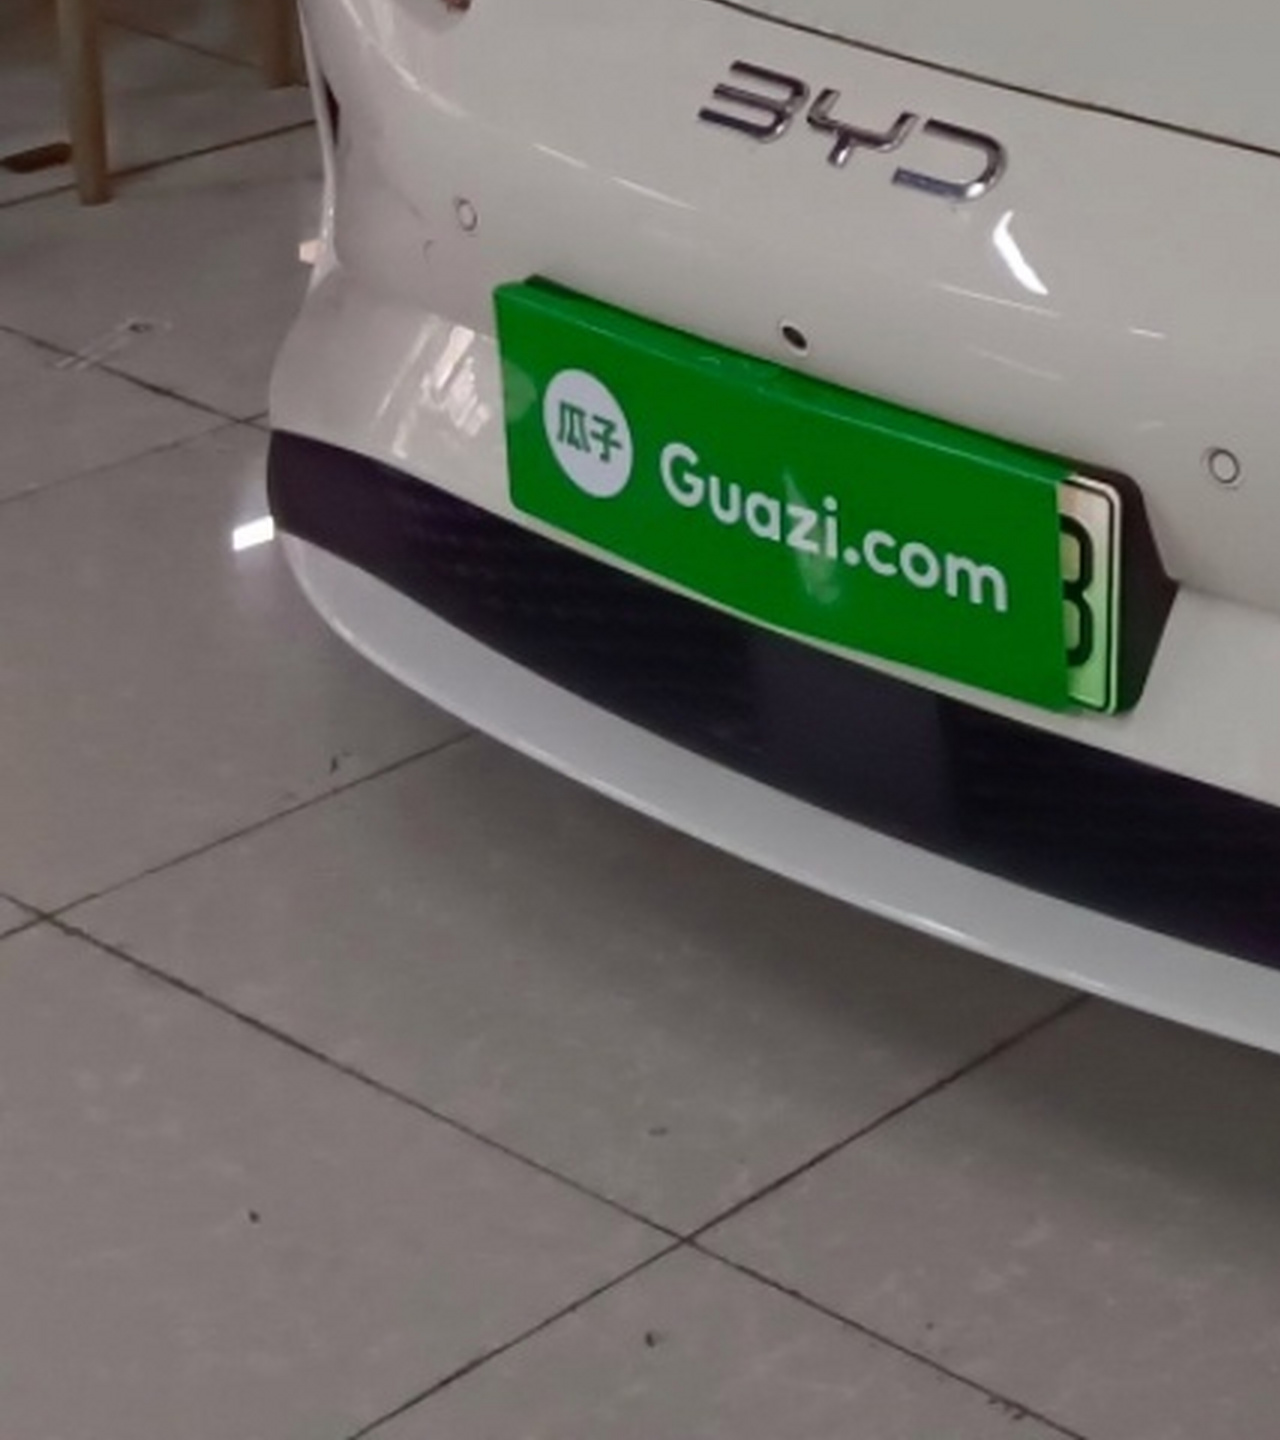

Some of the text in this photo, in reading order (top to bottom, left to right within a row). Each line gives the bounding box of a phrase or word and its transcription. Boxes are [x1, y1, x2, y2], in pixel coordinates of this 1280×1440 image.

[697, 59, 1008, 203] BYD
[556, 401, 623, 463] 瓜子
[660, 441, 1009, 613] Guazi.com
